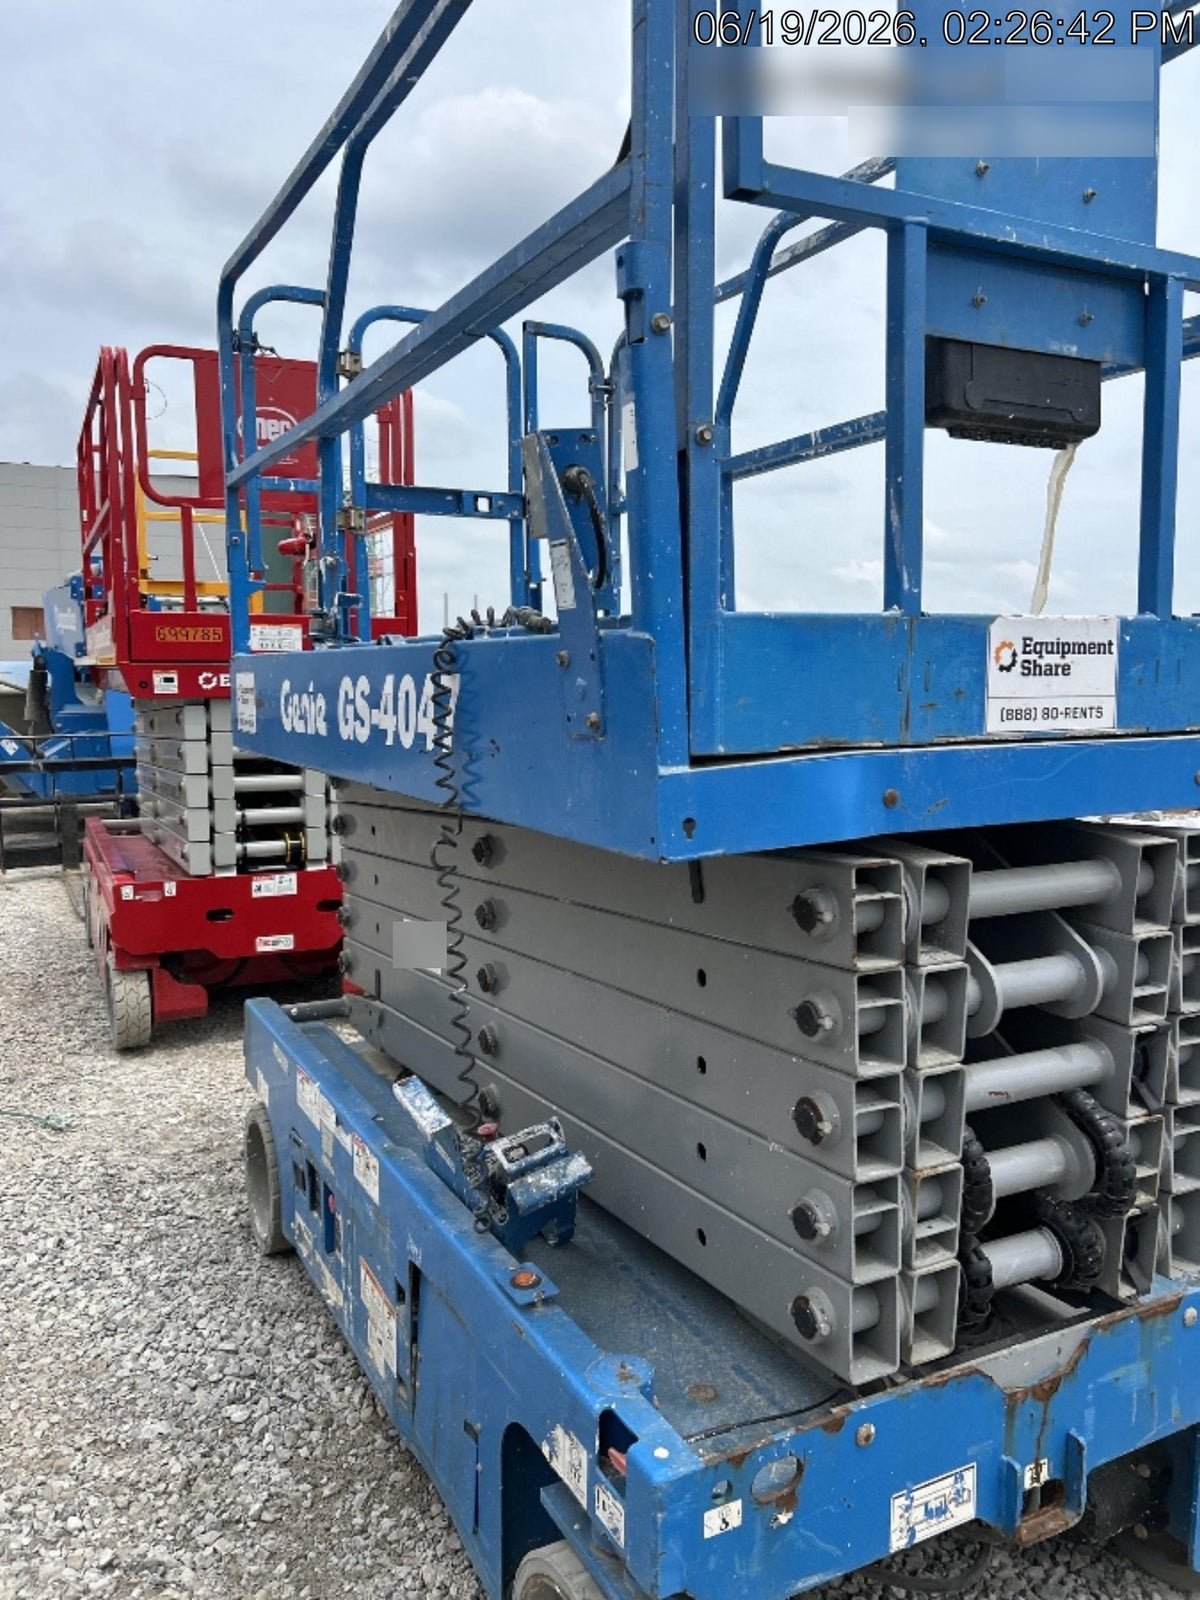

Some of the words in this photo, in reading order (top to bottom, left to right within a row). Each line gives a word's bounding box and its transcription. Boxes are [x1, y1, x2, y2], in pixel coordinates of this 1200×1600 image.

[1021, 637, 1114, 659] Equipment
[1021, 659, 1071, 677] Share
[280, 679, 327, 736] Genie
[1000, 707, 1038, 722] (888)
[1041, 706, 1103, 720] 80-RENTS
